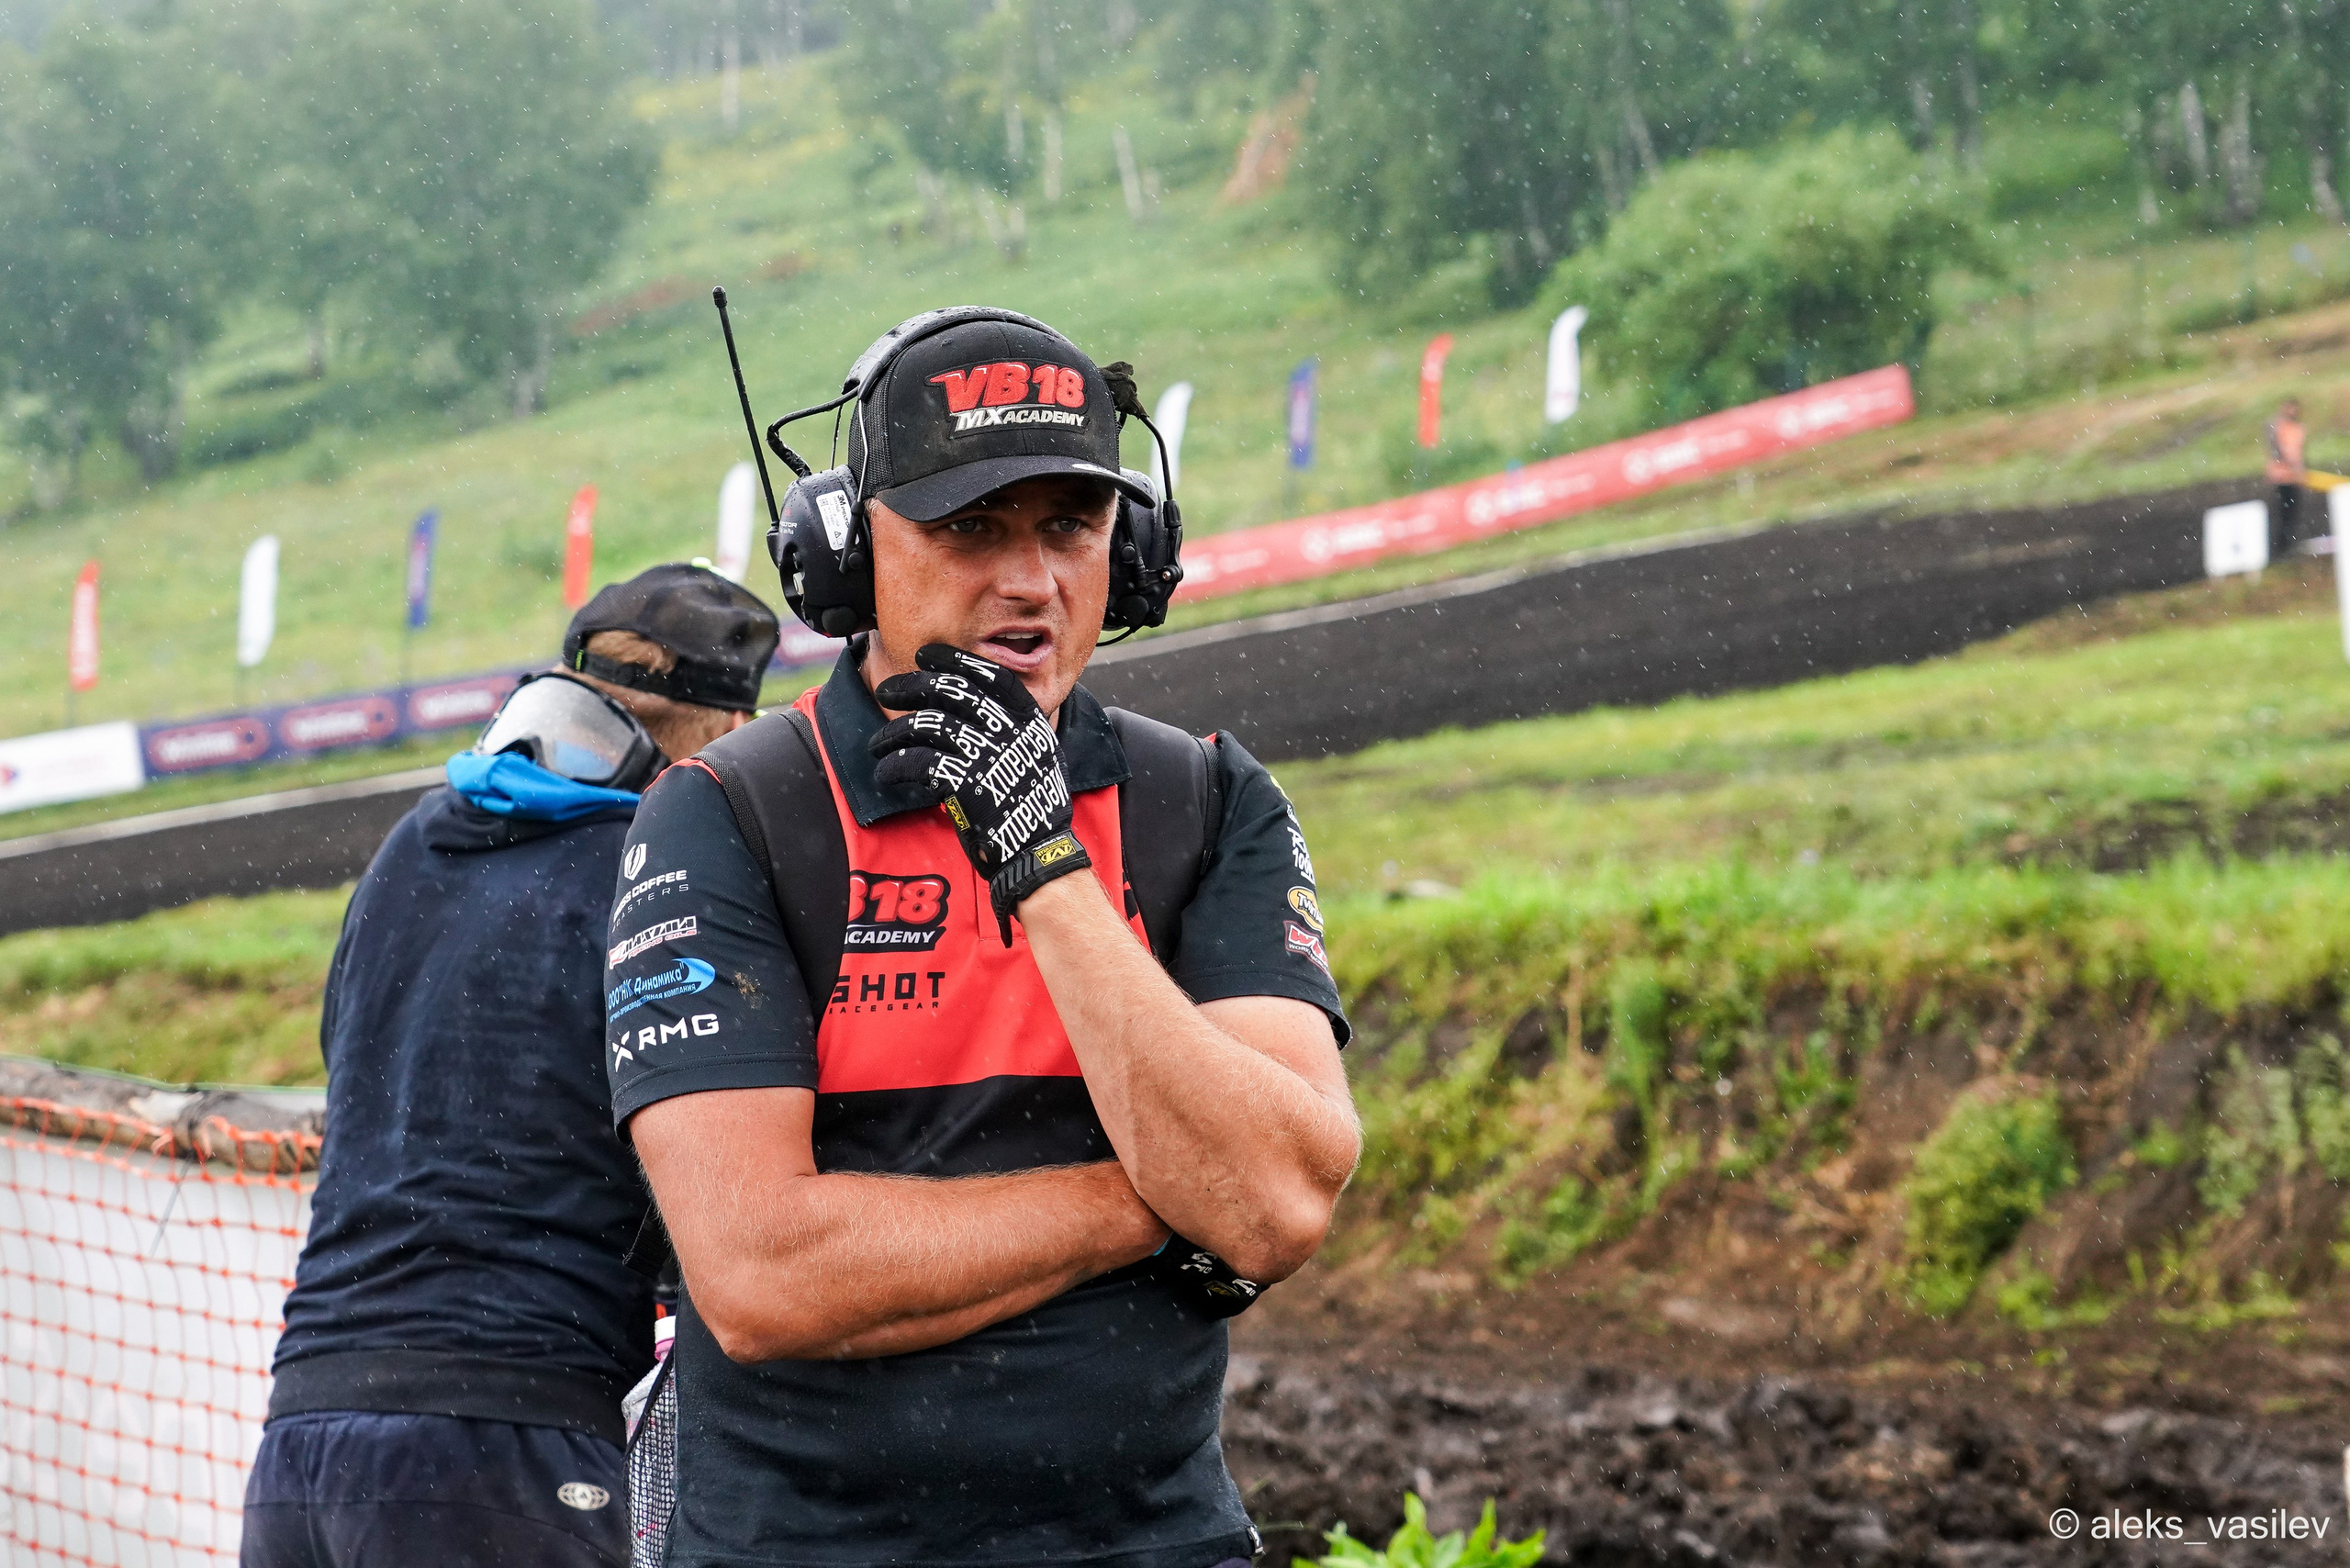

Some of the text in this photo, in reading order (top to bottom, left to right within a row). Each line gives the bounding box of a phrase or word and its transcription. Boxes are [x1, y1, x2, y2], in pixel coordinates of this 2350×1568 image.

[1003, 410, 1084, 427] ACADEMY
[632, 869, 688, 899] COFFEE
[664, 983, 697, 999] КОМПАНИЯ
[831, 972, 946, 1004] SHOT
[638, 1014, 720, 1051] RMG
